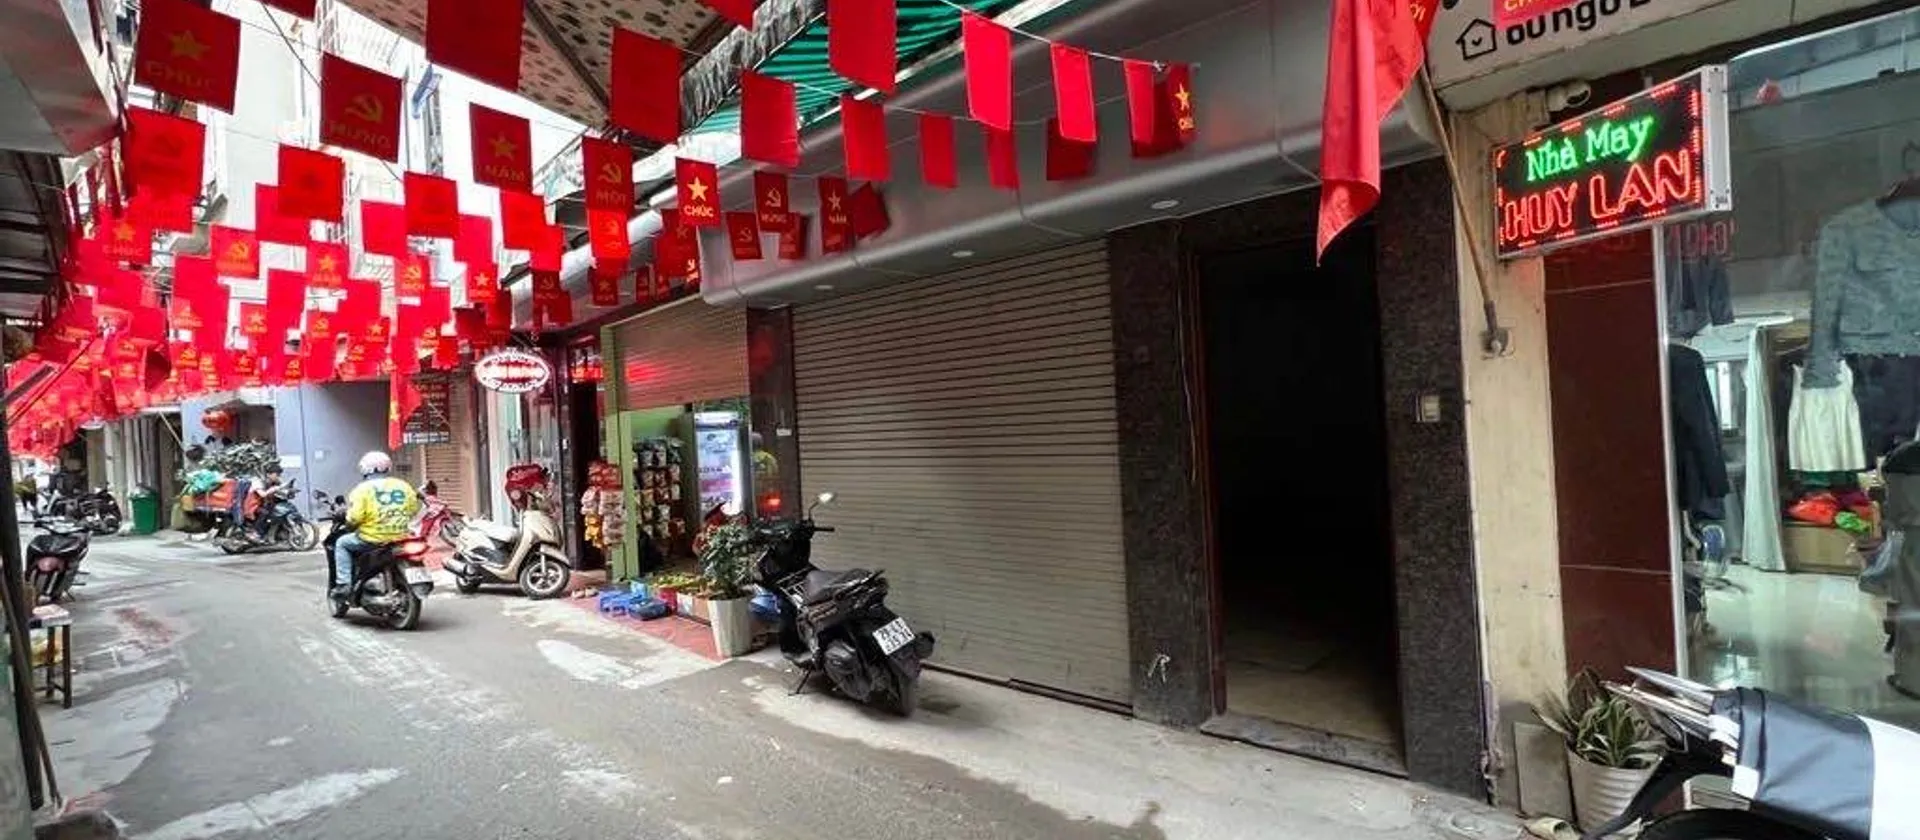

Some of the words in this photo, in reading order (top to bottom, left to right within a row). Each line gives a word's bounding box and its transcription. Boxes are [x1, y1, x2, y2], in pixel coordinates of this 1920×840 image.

[1525, 138, 1577, 182] Nhà
[1585, 116, 1653, 163] May
[1505, 181, 1577, 241] HUY
[1589, 148, 1690, 220] LAN
